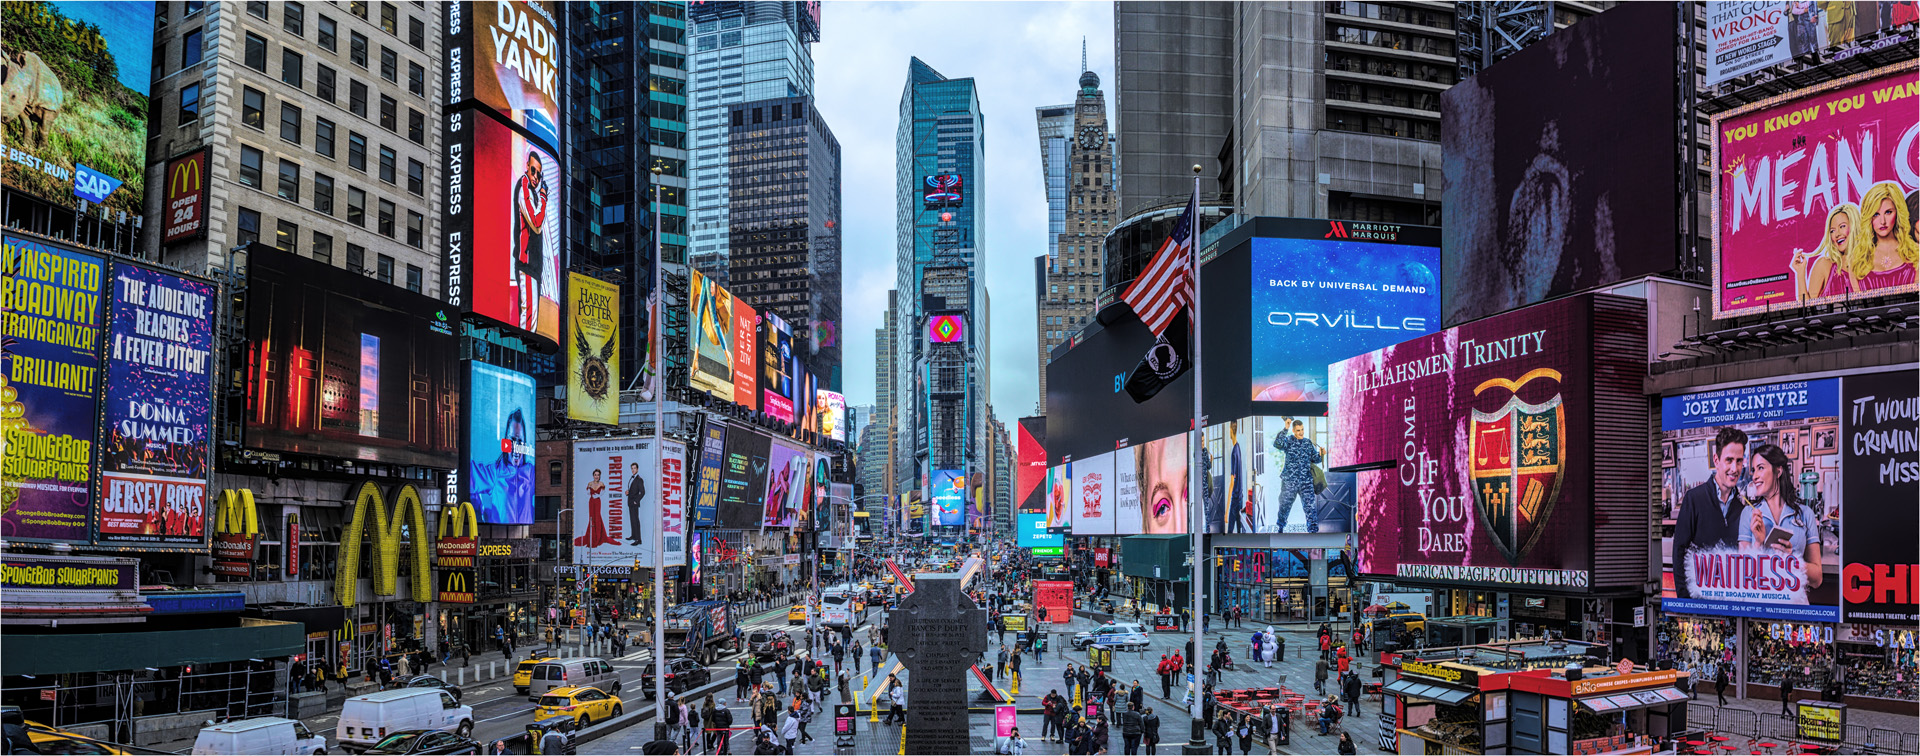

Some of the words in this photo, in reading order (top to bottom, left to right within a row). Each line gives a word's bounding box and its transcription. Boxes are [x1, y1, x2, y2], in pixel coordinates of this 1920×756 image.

[1711, 8, 1739, 25] THAT
[1711, 9, 1782, 41] WRONG
[1714, 43, 1738, 54] COMEDY
[1738, 39, 1750, 48] FOR
[1750, 35, 1762, 44] ALL
[1762, 30, 1777, 39] AGES
[1717, 42, 1727, 51] THE
[1728, 25, 1775, 46] SMASH-HIT-BANG
[1717, 55, 1724, 63] AT
[1724, 51, 1736, 61] NEW
[1736, 45, 1757, 57] WORLD
[1757, 38, 1777, 52] STAGES
[1745, 50, 1765, 60] STREET
[450, 47, 462, 104] EXPRESS
[1724, 122, 1758, 144] YOU
[1763, 105, 1821, 134] KNOW
[1826, 93, 1867, 116] YOU
[9, 147, 44, 171] BEST
[44, 163, 70, 182] RUN
[75, 169, 112, 200] SAP
[450, 143, 462, 215] EXPRESS
[1731, 128, 1874, 236] MEAN
[171, 194, 198, 210] OPEN
[173, 205, 195, 224] 24
[167, 221, 200, 238] HOURS
[1352, 222, 1401, 234] MARRIOTT
[1352, 231, 1396, 241] MARQUIS
[19, 247, 100, 293] INSPIRED
[448, 231, 461, 307] EXPRESS
[579, 286, 612, 308] HARRY
[1269, 279, 1298, 289] BACK
[1301, 280, 1315, 289] BY
[1319, 281, 1379, 292] UNIVERSAL
[1382, 284, 1426, 295] DEMAND
[1, 275, 99, 326] ROADWAY
[148, 283, 207, 320] AUDIENCE
[577, 299, 615, 323] POTTER
[135, 308, 190, 344] REACHES
[1267, 311, 1427, 332] ORVILLE
[113, 333, 122, 360] A
[125, 335, 164, 368] FEVER
[1352, 351, 1455, 399] JILLIAHSMEN
[1460, 329, 1547, 369] TRINITY
[1114, 370, 1126, 393] BY
[1682, 394, 1695, 402] NOW
[1697, 391, 1726, 401] STARRING
[1726, 389, 1740, 398] NEW
[1741, 387, 1755, 396] KIDS
[1757, 386, 1766, 394] ON
[1768, 385, 1781, 393] THE
[1782, 381, 1808, 392] BLOCK'S
[129, 400, 187, 426] DONNA
[1682, 399, 1720, 418] JOEY
[1725, 390, 1809, 414] McINTYRE
[1852, 395, 1876, 427] IT
[1703, 414, 1735, 424] THROUGH
[1735, 412, 1756, 422] APRIL
[1762, 409, 1784, 419] ONLY!
[120, 419, 195, 447] SUMMER
[1399, 395, 1417, 487] COME
[5, 428, 92, 467] SPONGEBOB
[145, 442, 168, 450] MUSICAL
[4, 457, 90, 483] SQUAREPANTS
[608, 455, 623, 492] PRETTY
[701, 465, 720, 481] COME
[1119, 472, 1132, 483] What
[1417, 451, 1439, 486] IF
[37, 482, 59, 492] MUSICAL
[103, 478, 164, 515] JERSEY
[165, 483, 203, 518] BOYS
[670, 458, 682, 535] PRETTY
[1119, 484, 1132, 496] make
[698, 492, 718, 508] AWAY
[1417, 488, 1465, 523] YOU
[16, 509, 86, 521] SpongeBobBroadway.com
[608, 498, 623, 541] WOMAN
[212, 541, 252, 551] McDonald's
[437, 542, 475, 550] McDonald's
[478, 544, 512, 556] EXPRESS
[1417, 526, 1465, 553] DARE
[0, 563, 56, 585] SPONGEBOB
[57, 566, 119, 586] SQUAREPANTS
[586, 566, 631, 575] LUGGAGE
[1397, 564, 1455, 581] AMERICAN
[1459, 568, 1496, 583] EAGLE
[1498, 569, 1589, 588] OUTFITTERS
[1692, 552, 1802, 593] WAITRESS
[1701, 590, 1713, 598] THE
[1725, 591, 1760, 600] BROADWAY
[1761, 593, 1791, 602] MUSICAL
[1667, 601, 1684, 609] BROOKS
[1764, 607, 1836, 617] WAITRESSTHEMUSICAL.COM
[1884, 612, 1907, 620] THEATRE
[908, 624, 936, 632] FRANCIS
[944, 624, 969, 632] DUFFY
[1771, 622, 1834, 645] GRAND
[1401, 660, 1462, 683] wafels&dinges
[1596, 680, 1615, 688] CHINESE
